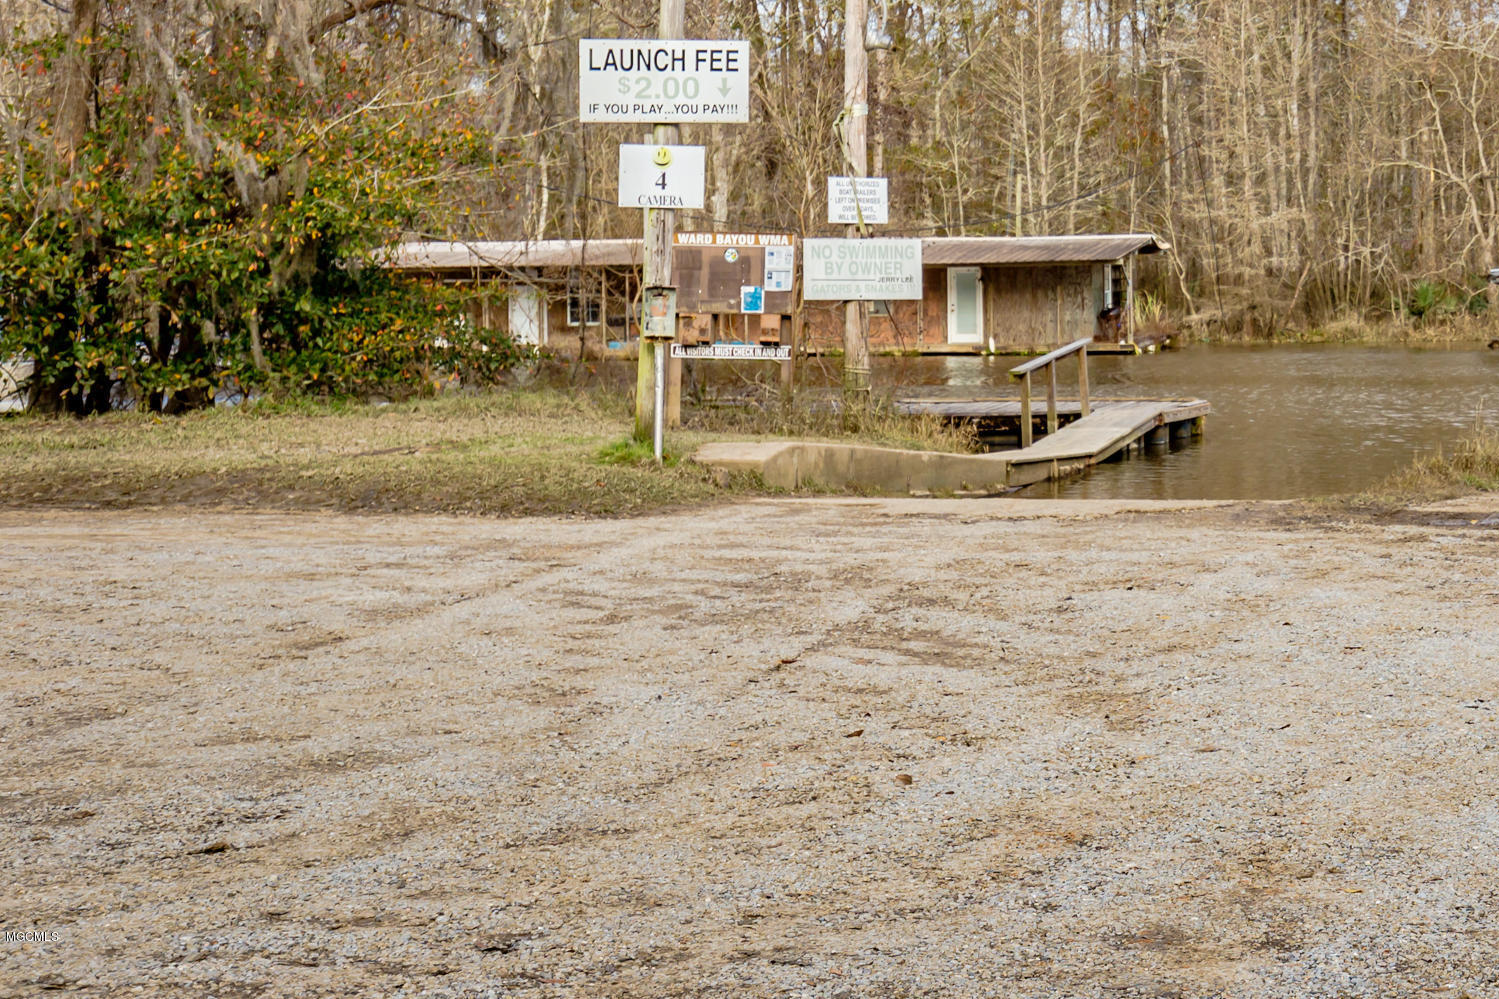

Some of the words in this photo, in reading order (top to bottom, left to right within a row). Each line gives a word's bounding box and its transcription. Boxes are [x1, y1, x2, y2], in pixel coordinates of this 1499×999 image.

[588, 48, 686, 72] LAUNCH
[695, 49, 739, 72] FEE
[618, 76, 700, 100] $2.00
[588, 104, 600, 114] IF
[604, 104, 629, 114] YOU
[702, 104, 738, 114] PAY!!!
[655, 171, 667, 190] 4
[839, 189, 852, 197] BOAT
[638, 194, 683, 206] CAMERA
[677, 233, 714, 244] WARD
[716, 234, 755, 245] BAYOU
[758, 235, 789, 246] WMA
[811, 245, 833, 260] NO
[838, 245, 915, 260] SWIMMING
[825, 261, 844, 275] BY
[848, 261, 903, 275] OWNER
[674, 346, 686, 356] ALL
[687, 346, 713, 357] VISITORS
[715, 347, 732, 357] MUST
[733, 347, 754, 357] CHECK
[755, 347, 762, 357] IN
[763, 347, 776, 357] AND
[777, 347, 789, 357] OUT
